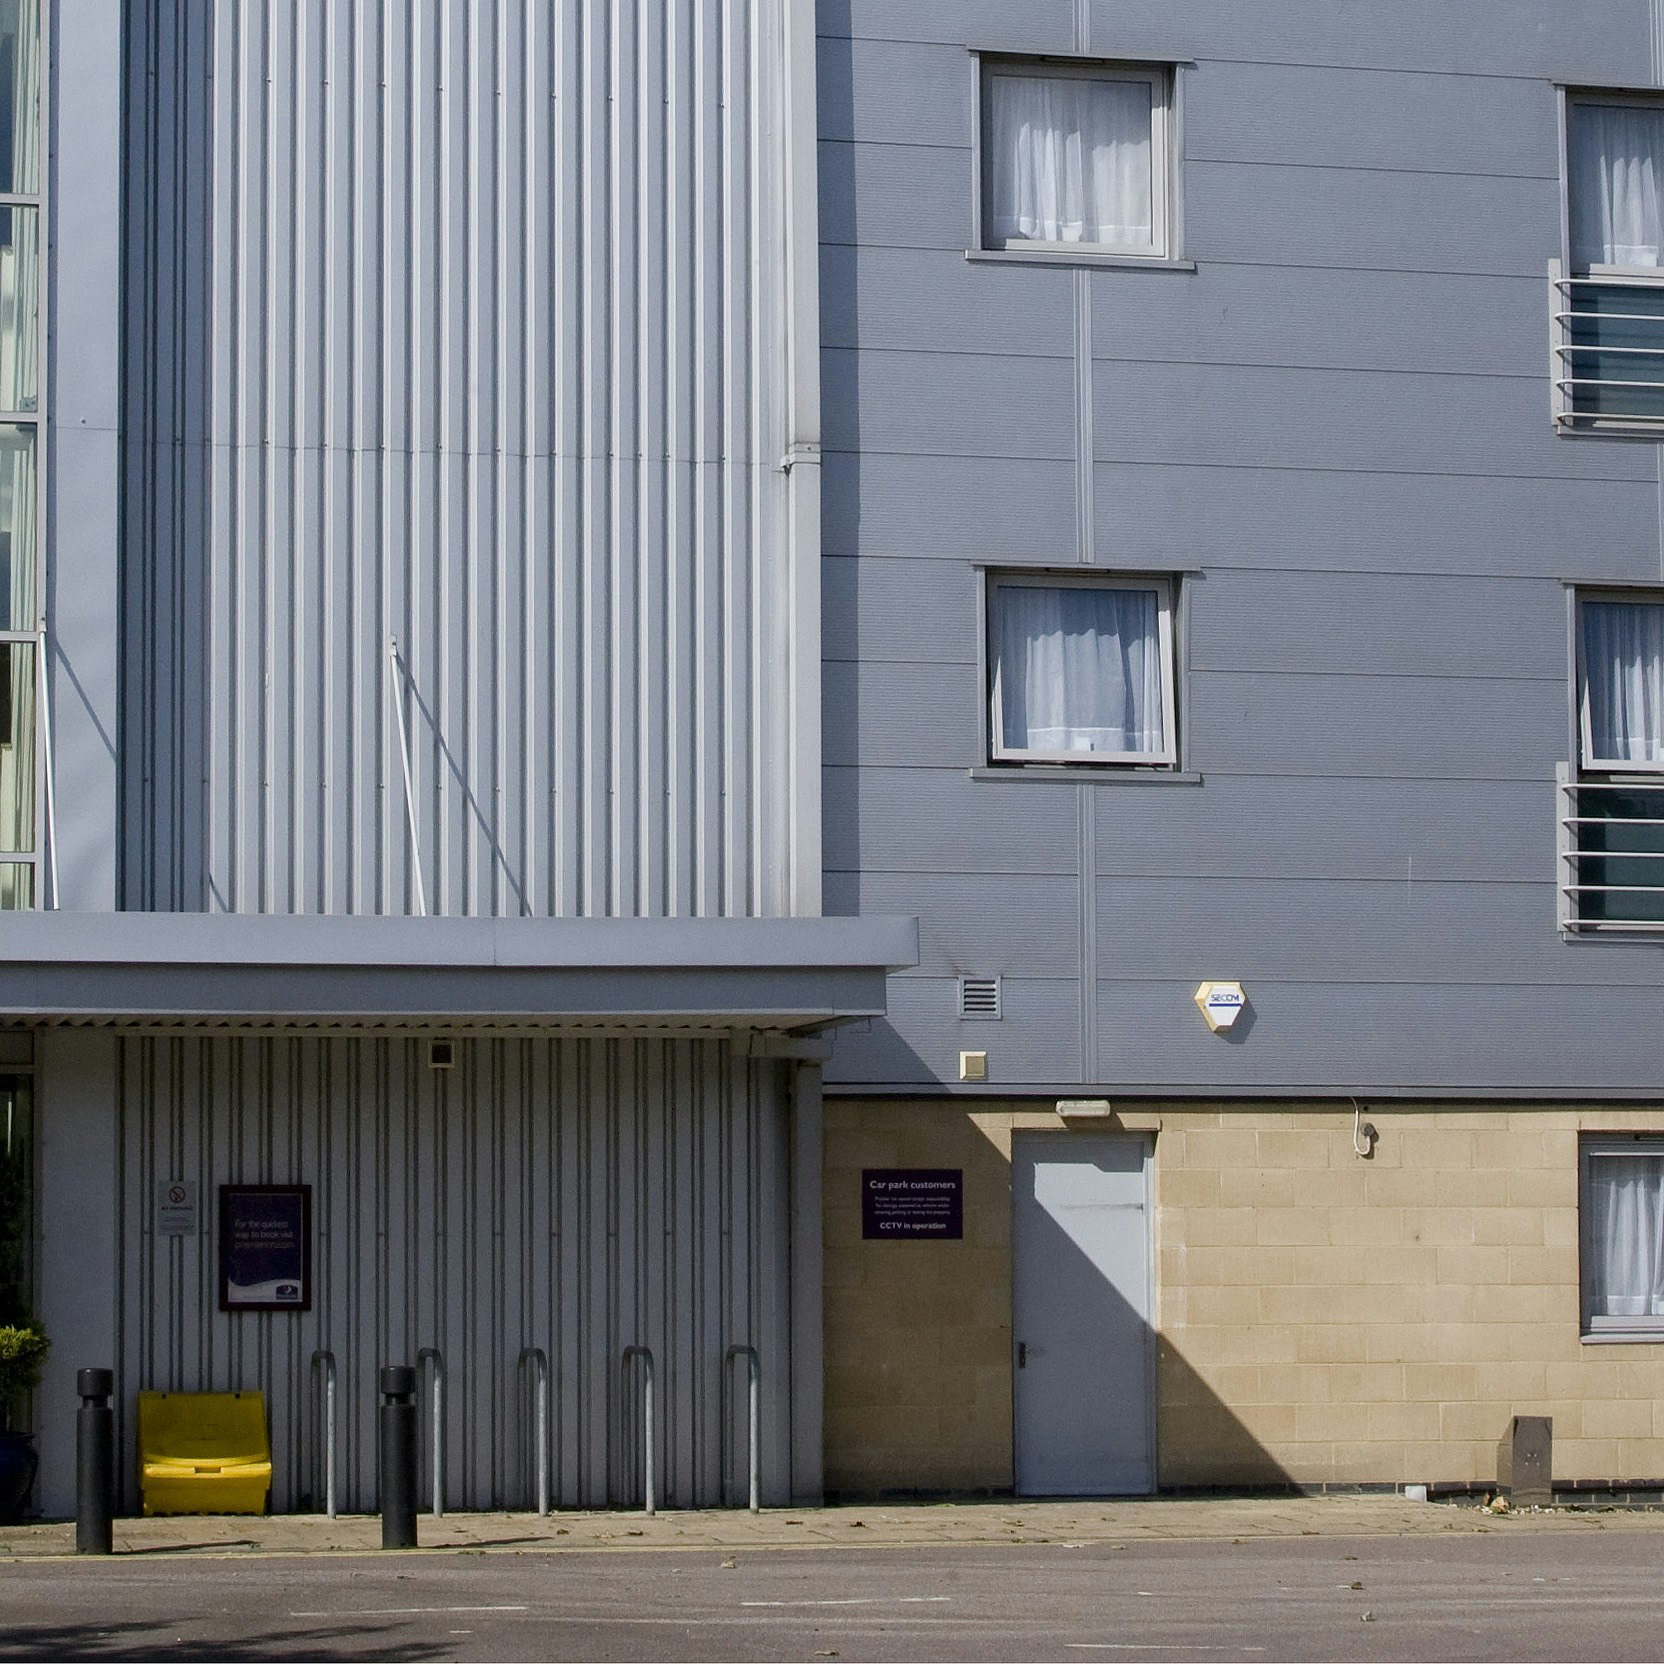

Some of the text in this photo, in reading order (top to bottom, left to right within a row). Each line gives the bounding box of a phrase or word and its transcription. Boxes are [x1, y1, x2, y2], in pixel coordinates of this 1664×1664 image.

[869, 1180, 956, 1192] Car park customers
[912, 1222, 947, 1231] operation
